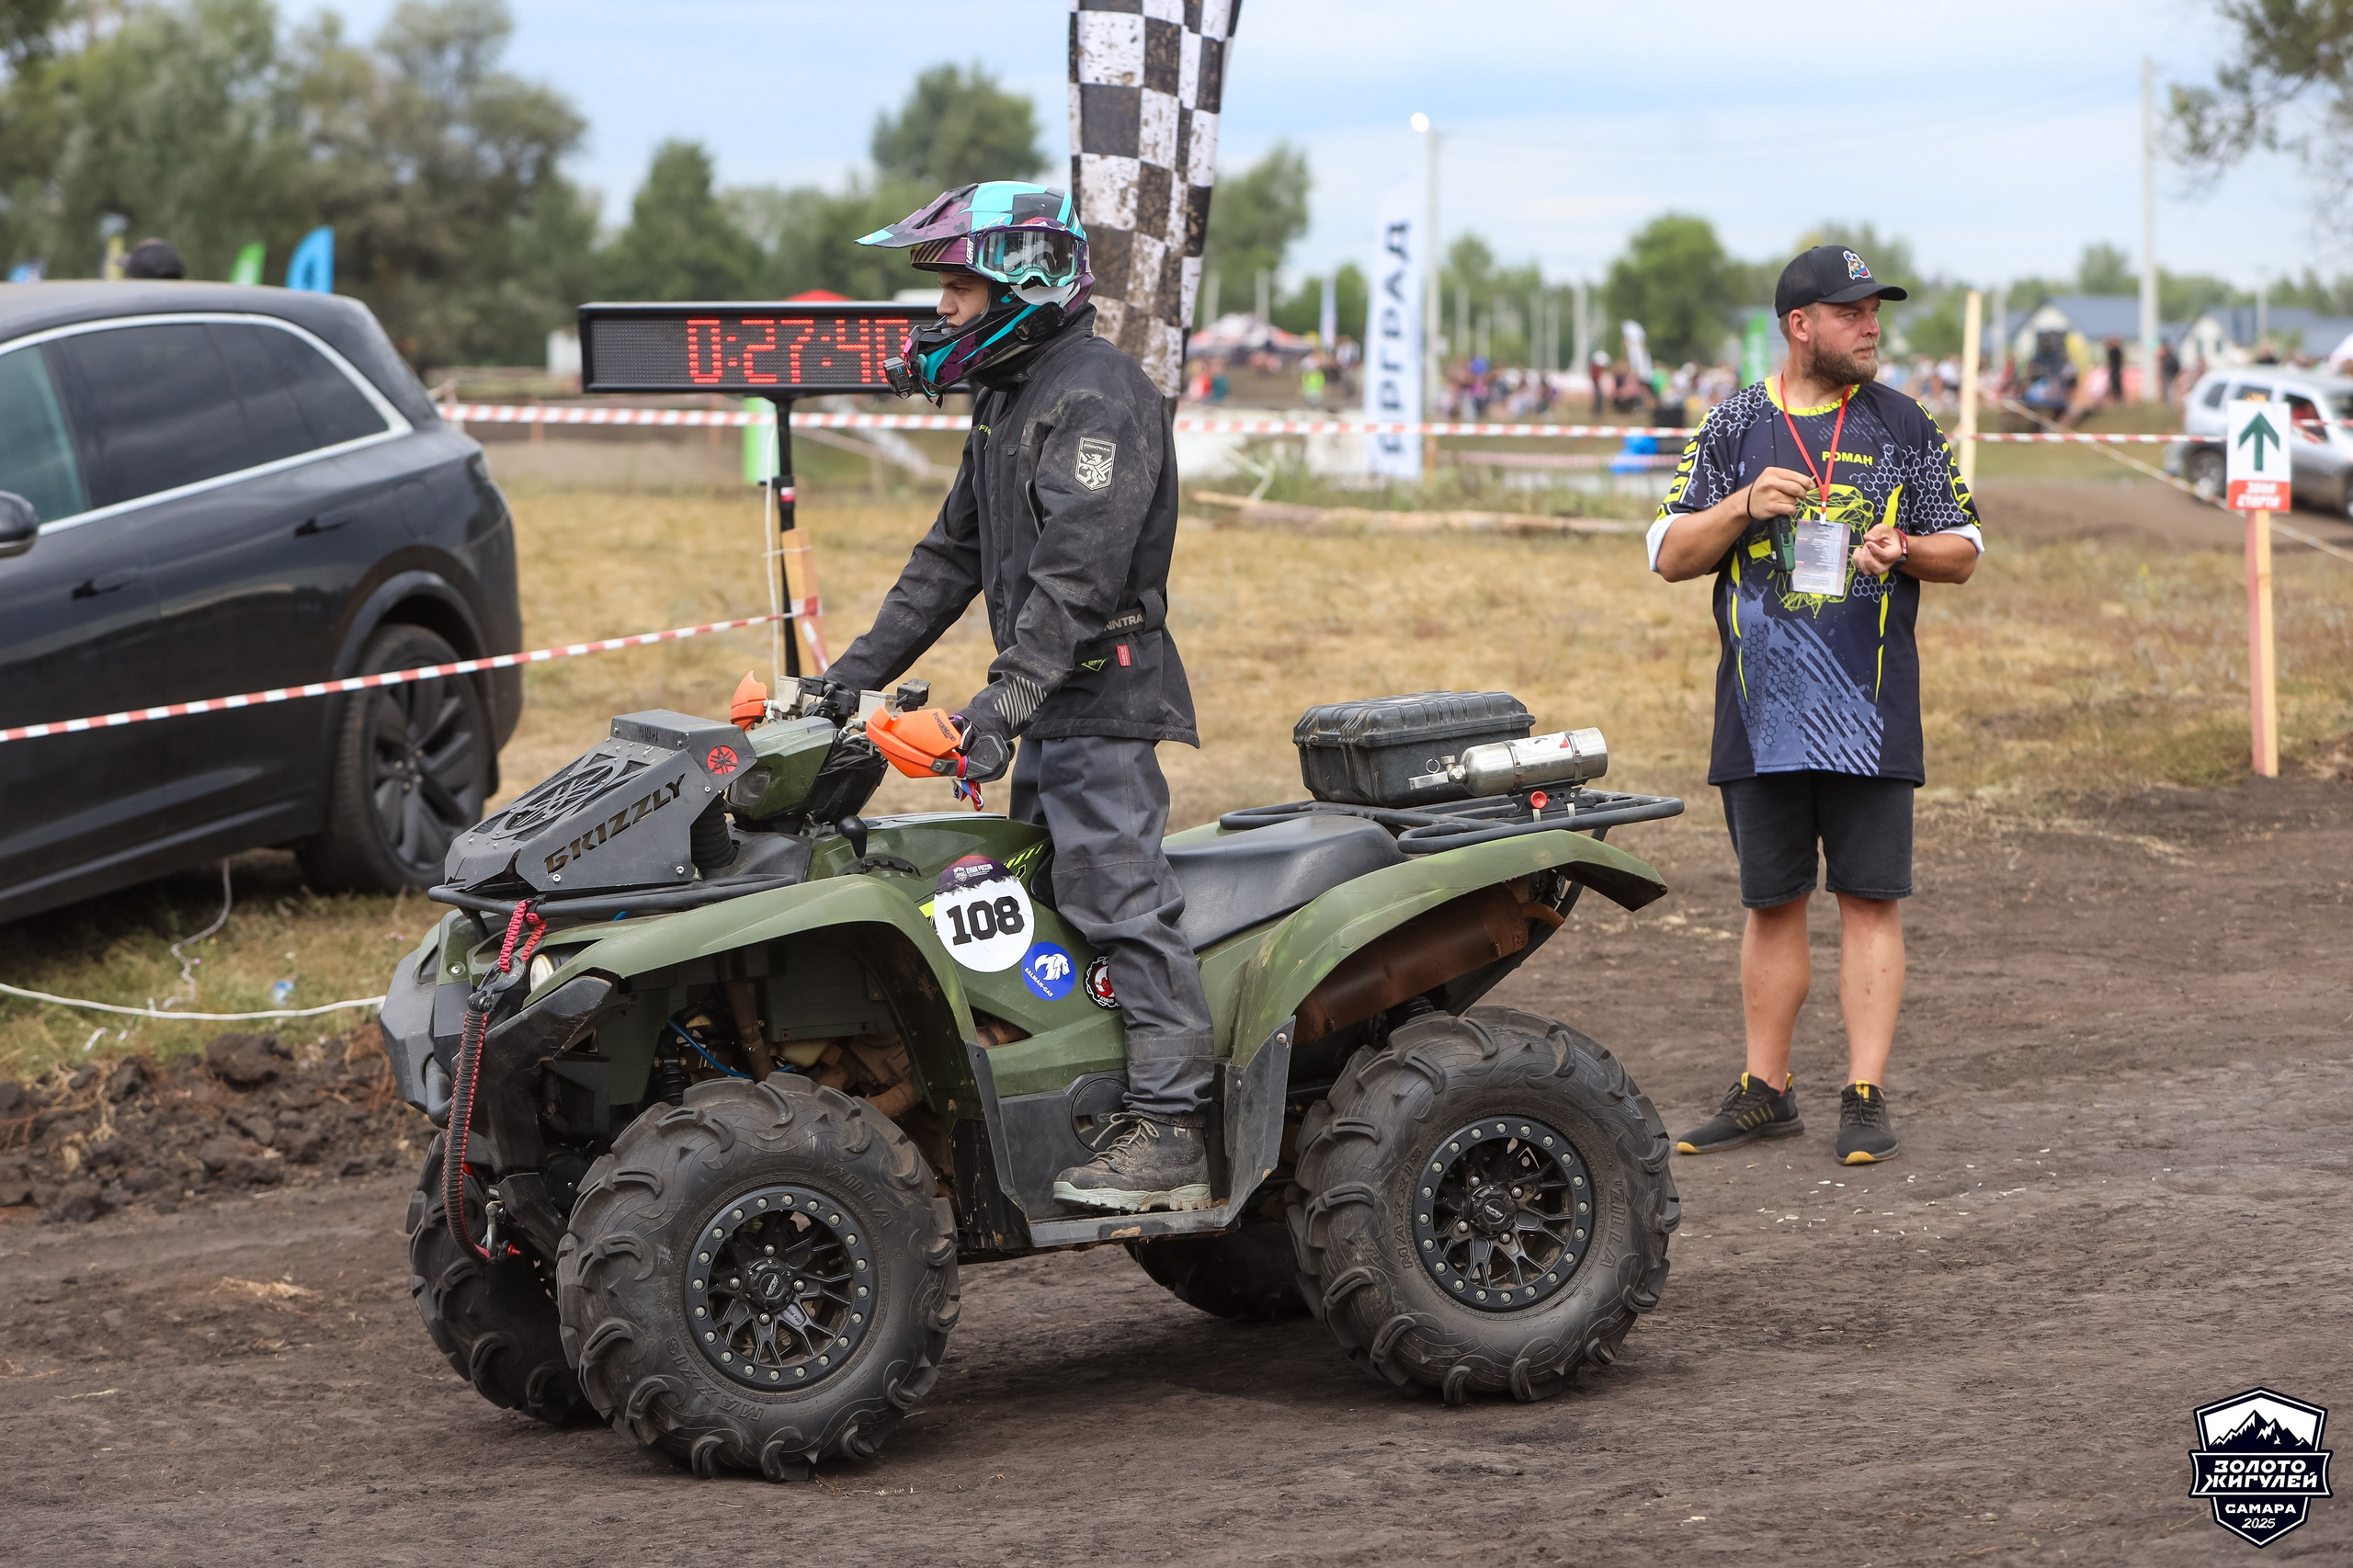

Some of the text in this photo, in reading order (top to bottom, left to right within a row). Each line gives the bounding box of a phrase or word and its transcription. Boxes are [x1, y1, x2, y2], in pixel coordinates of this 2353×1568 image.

[965, 240, 975, 265] LEATT
[946, 895, 1025, 946] 108
[1024, 967, 1054, 998] SALMAN-GAS
[1393, 1146, 1423, 1269] MAXXIS
[666, 1335, 766, 1422] MAXXIS
